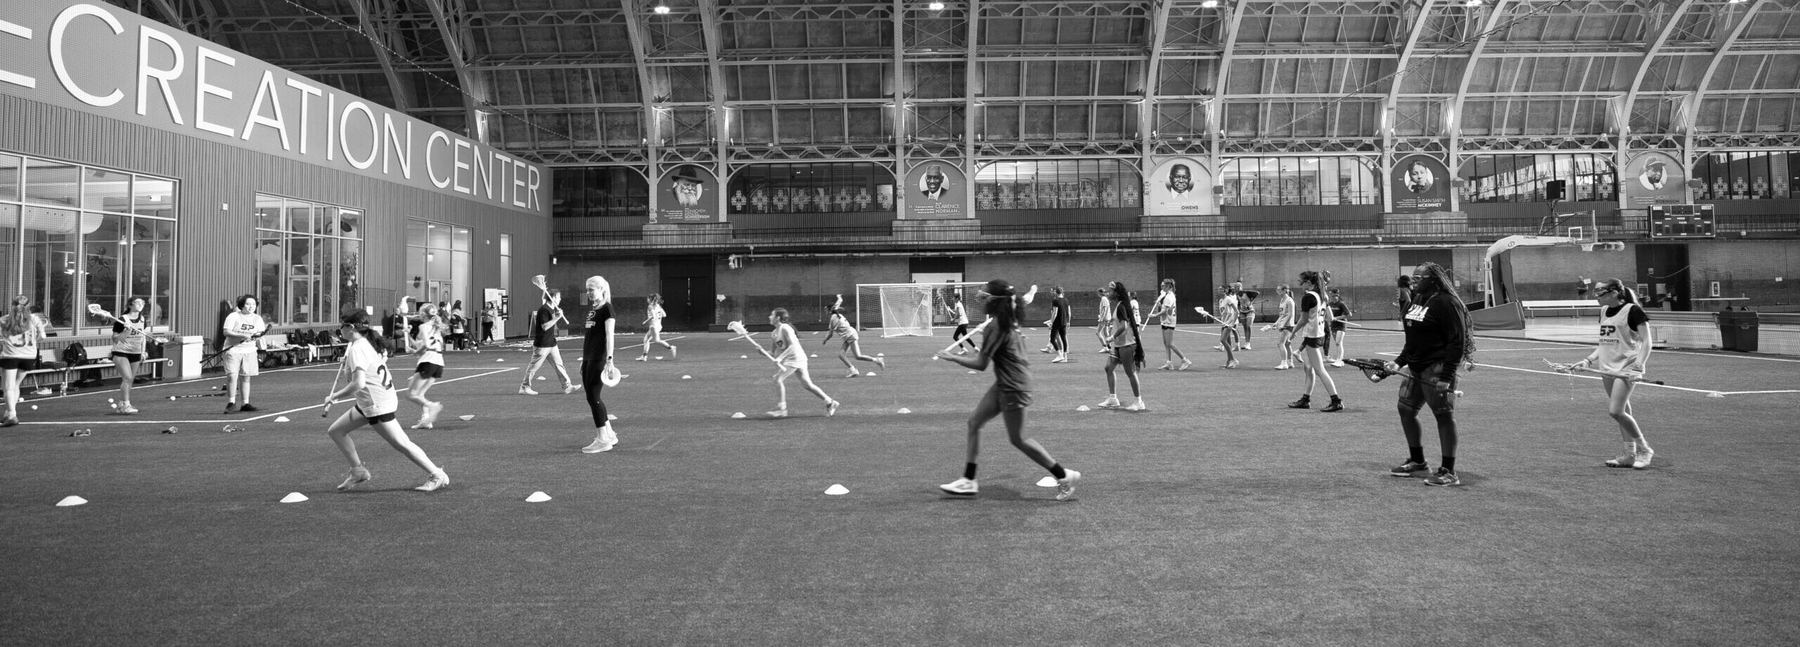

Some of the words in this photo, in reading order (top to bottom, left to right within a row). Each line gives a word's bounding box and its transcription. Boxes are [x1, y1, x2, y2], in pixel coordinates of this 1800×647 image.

[426, 130, 540, 212] CENTER
[240, 323, 254, 331] SP
[1600, 325, 1616, 336] SP
